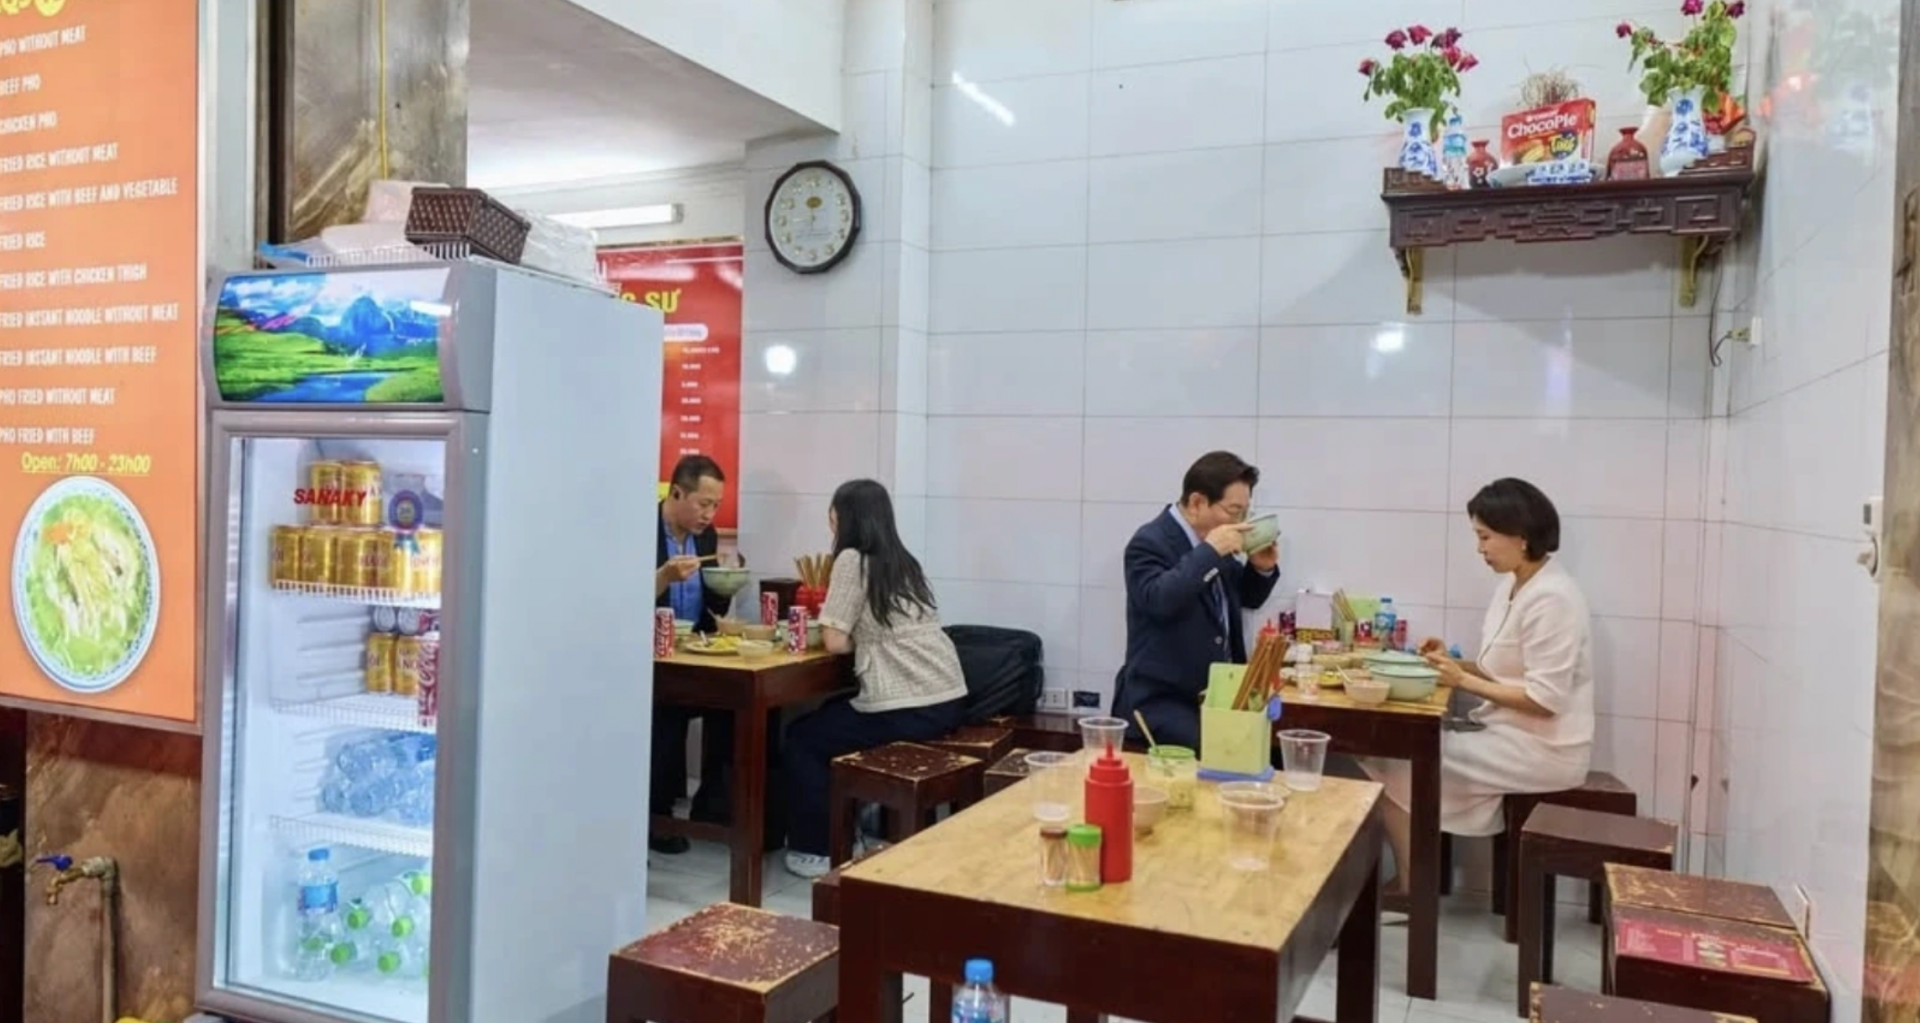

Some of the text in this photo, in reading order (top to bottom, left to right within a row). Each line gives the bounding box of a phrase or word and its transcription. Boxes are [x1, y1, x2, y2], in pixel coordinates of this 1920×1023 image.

[19, 30, 59, 52] WITHOUT
[61, 25, 86, 45] MEAT
[22, 73, 41, 92] PHO
[38, 111, 57, 130] PHO
[1507, 113, 1578, 139] ChocoPie
[25, 152, 46, 170] RICE
[48, 146, 90, 168] WITHOUT
[92, 142, 118, 162] MEAT
[25, 192, 46, 210] RICE
[48, 187, 73, 207] WITH
[74, 186, 98, 204] BEEF
[99, 184, 120, 202] AND
[122, 177, 178, 199] VEGETABLE
[25, 231, 46, 248] RICE
[25, 270, 46, 287] RICE
[48, 268, 73, 286] WITH
[73, 265, 115, 284] CHICKEN
[116, 262, 147, 281] THIGH
[25, 308, 63, 327] INSTANT
[65, 307, 102, 325] NOODLE
[104, 304, 149, 323] WITHOUT
[151, 302, 179, 321] MEAT
[25, 348, 63, 366] INSTANT
[65, 347, 102, 365] NOODLE
[104, 346, 131, 364] WITH
[132, 345, 157, 364] BEEF
[18, 388, 44, 405] FRIED
[46, 387, 88, 406] WITHOUT
[90, 387, 116, 405] MEAT
[18, 428, 44, 444] FRIED
[46, 427, 69, 445] WITH
[71, 427, 95, 445] BEEF
[21, 451, 61, 474] Open:
[66, 452, 99, 472] 7h00
[108, 453, 152, 474] 23h00
[293, 488, 367, 507] SANAKY
